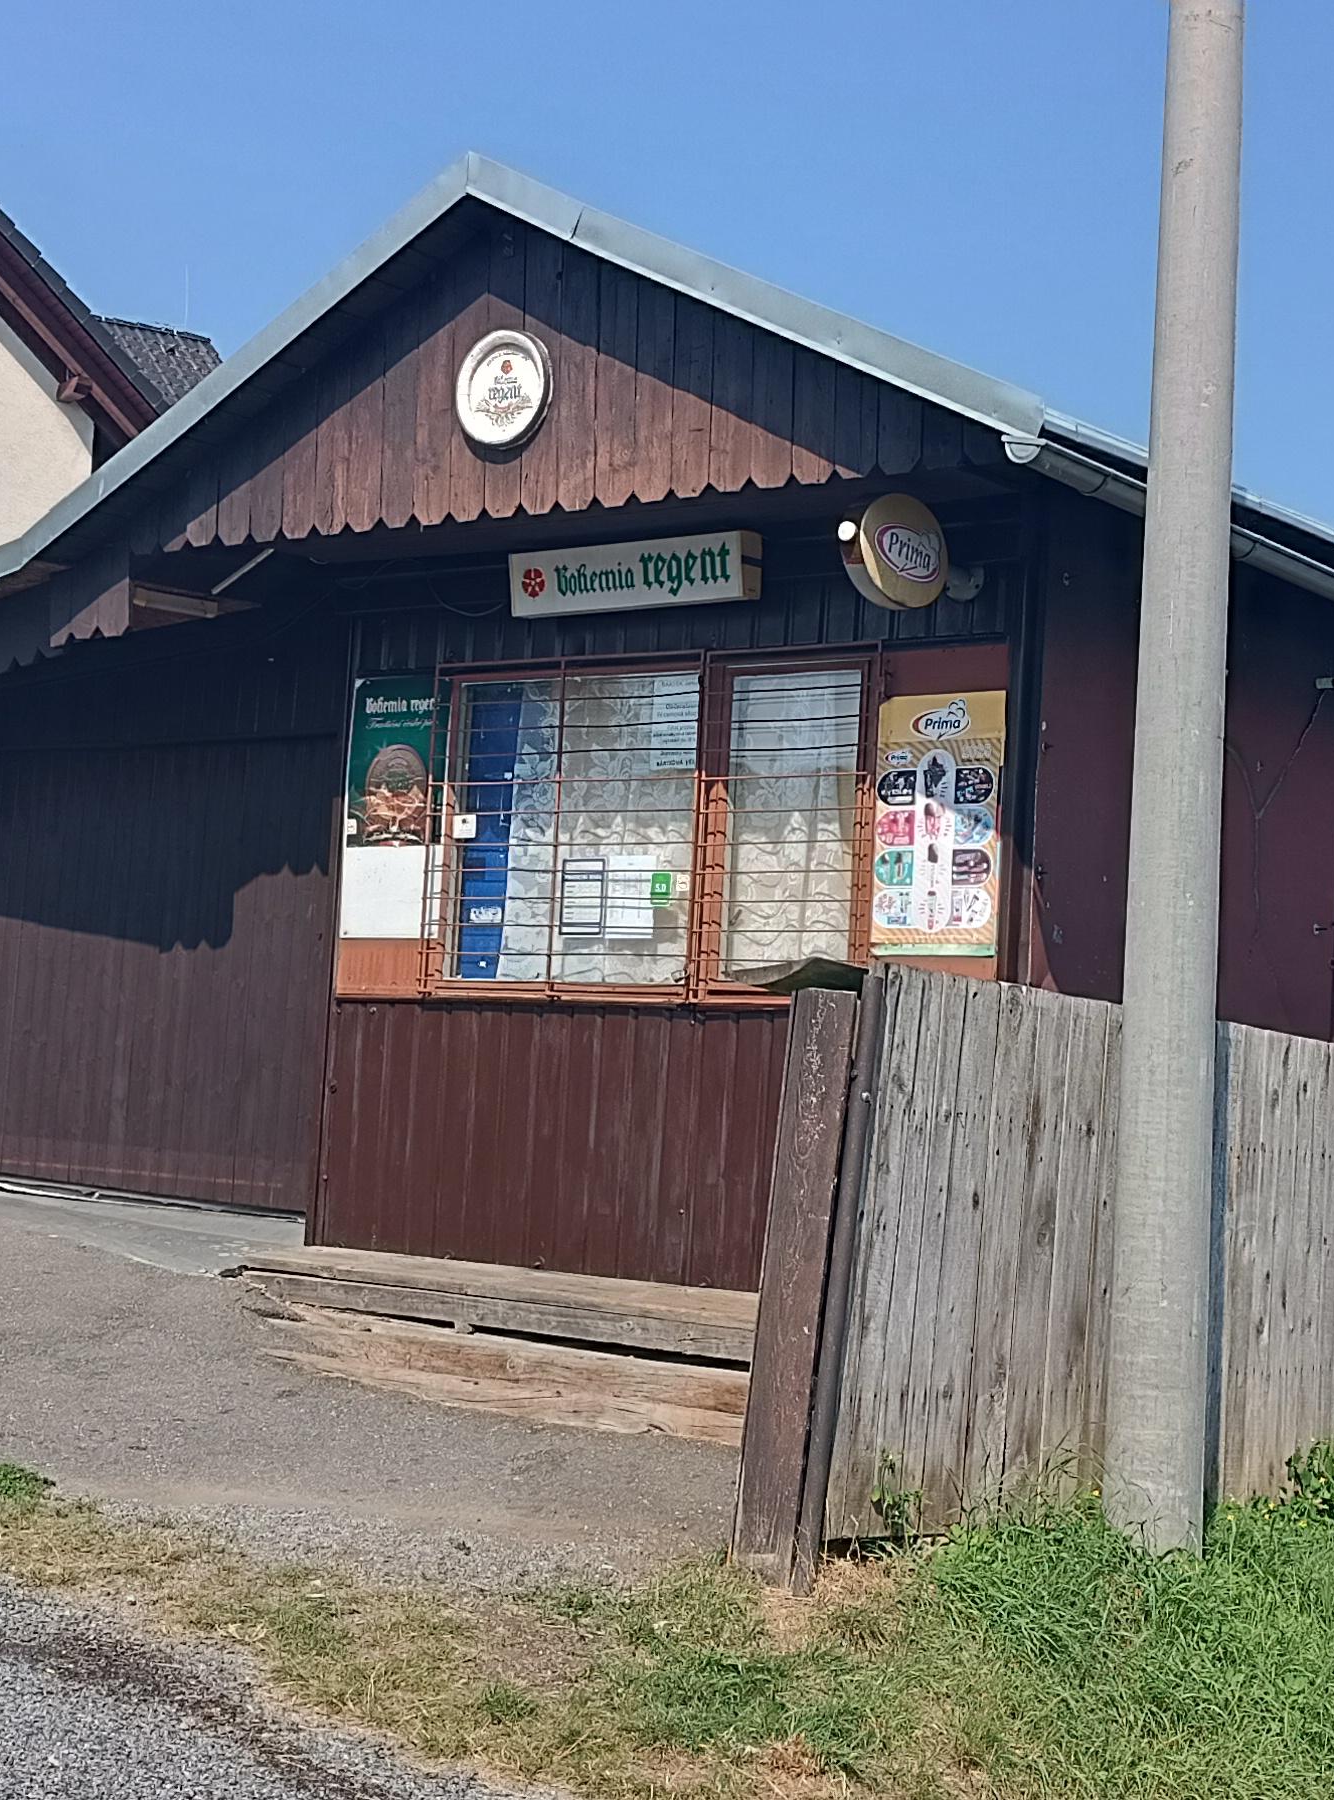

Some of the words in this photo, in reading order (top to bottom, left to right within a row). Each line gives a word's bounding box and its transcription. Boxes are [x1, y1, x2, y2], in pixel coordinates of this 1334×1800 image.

[888, 531, 931, 572] Prima
[554, 562, 635, 597] Bohemia
[639, 542, 730, 596] regent
[365, 697, 407, 713] Bohemia
[924, 717, 961, 730] Prima
